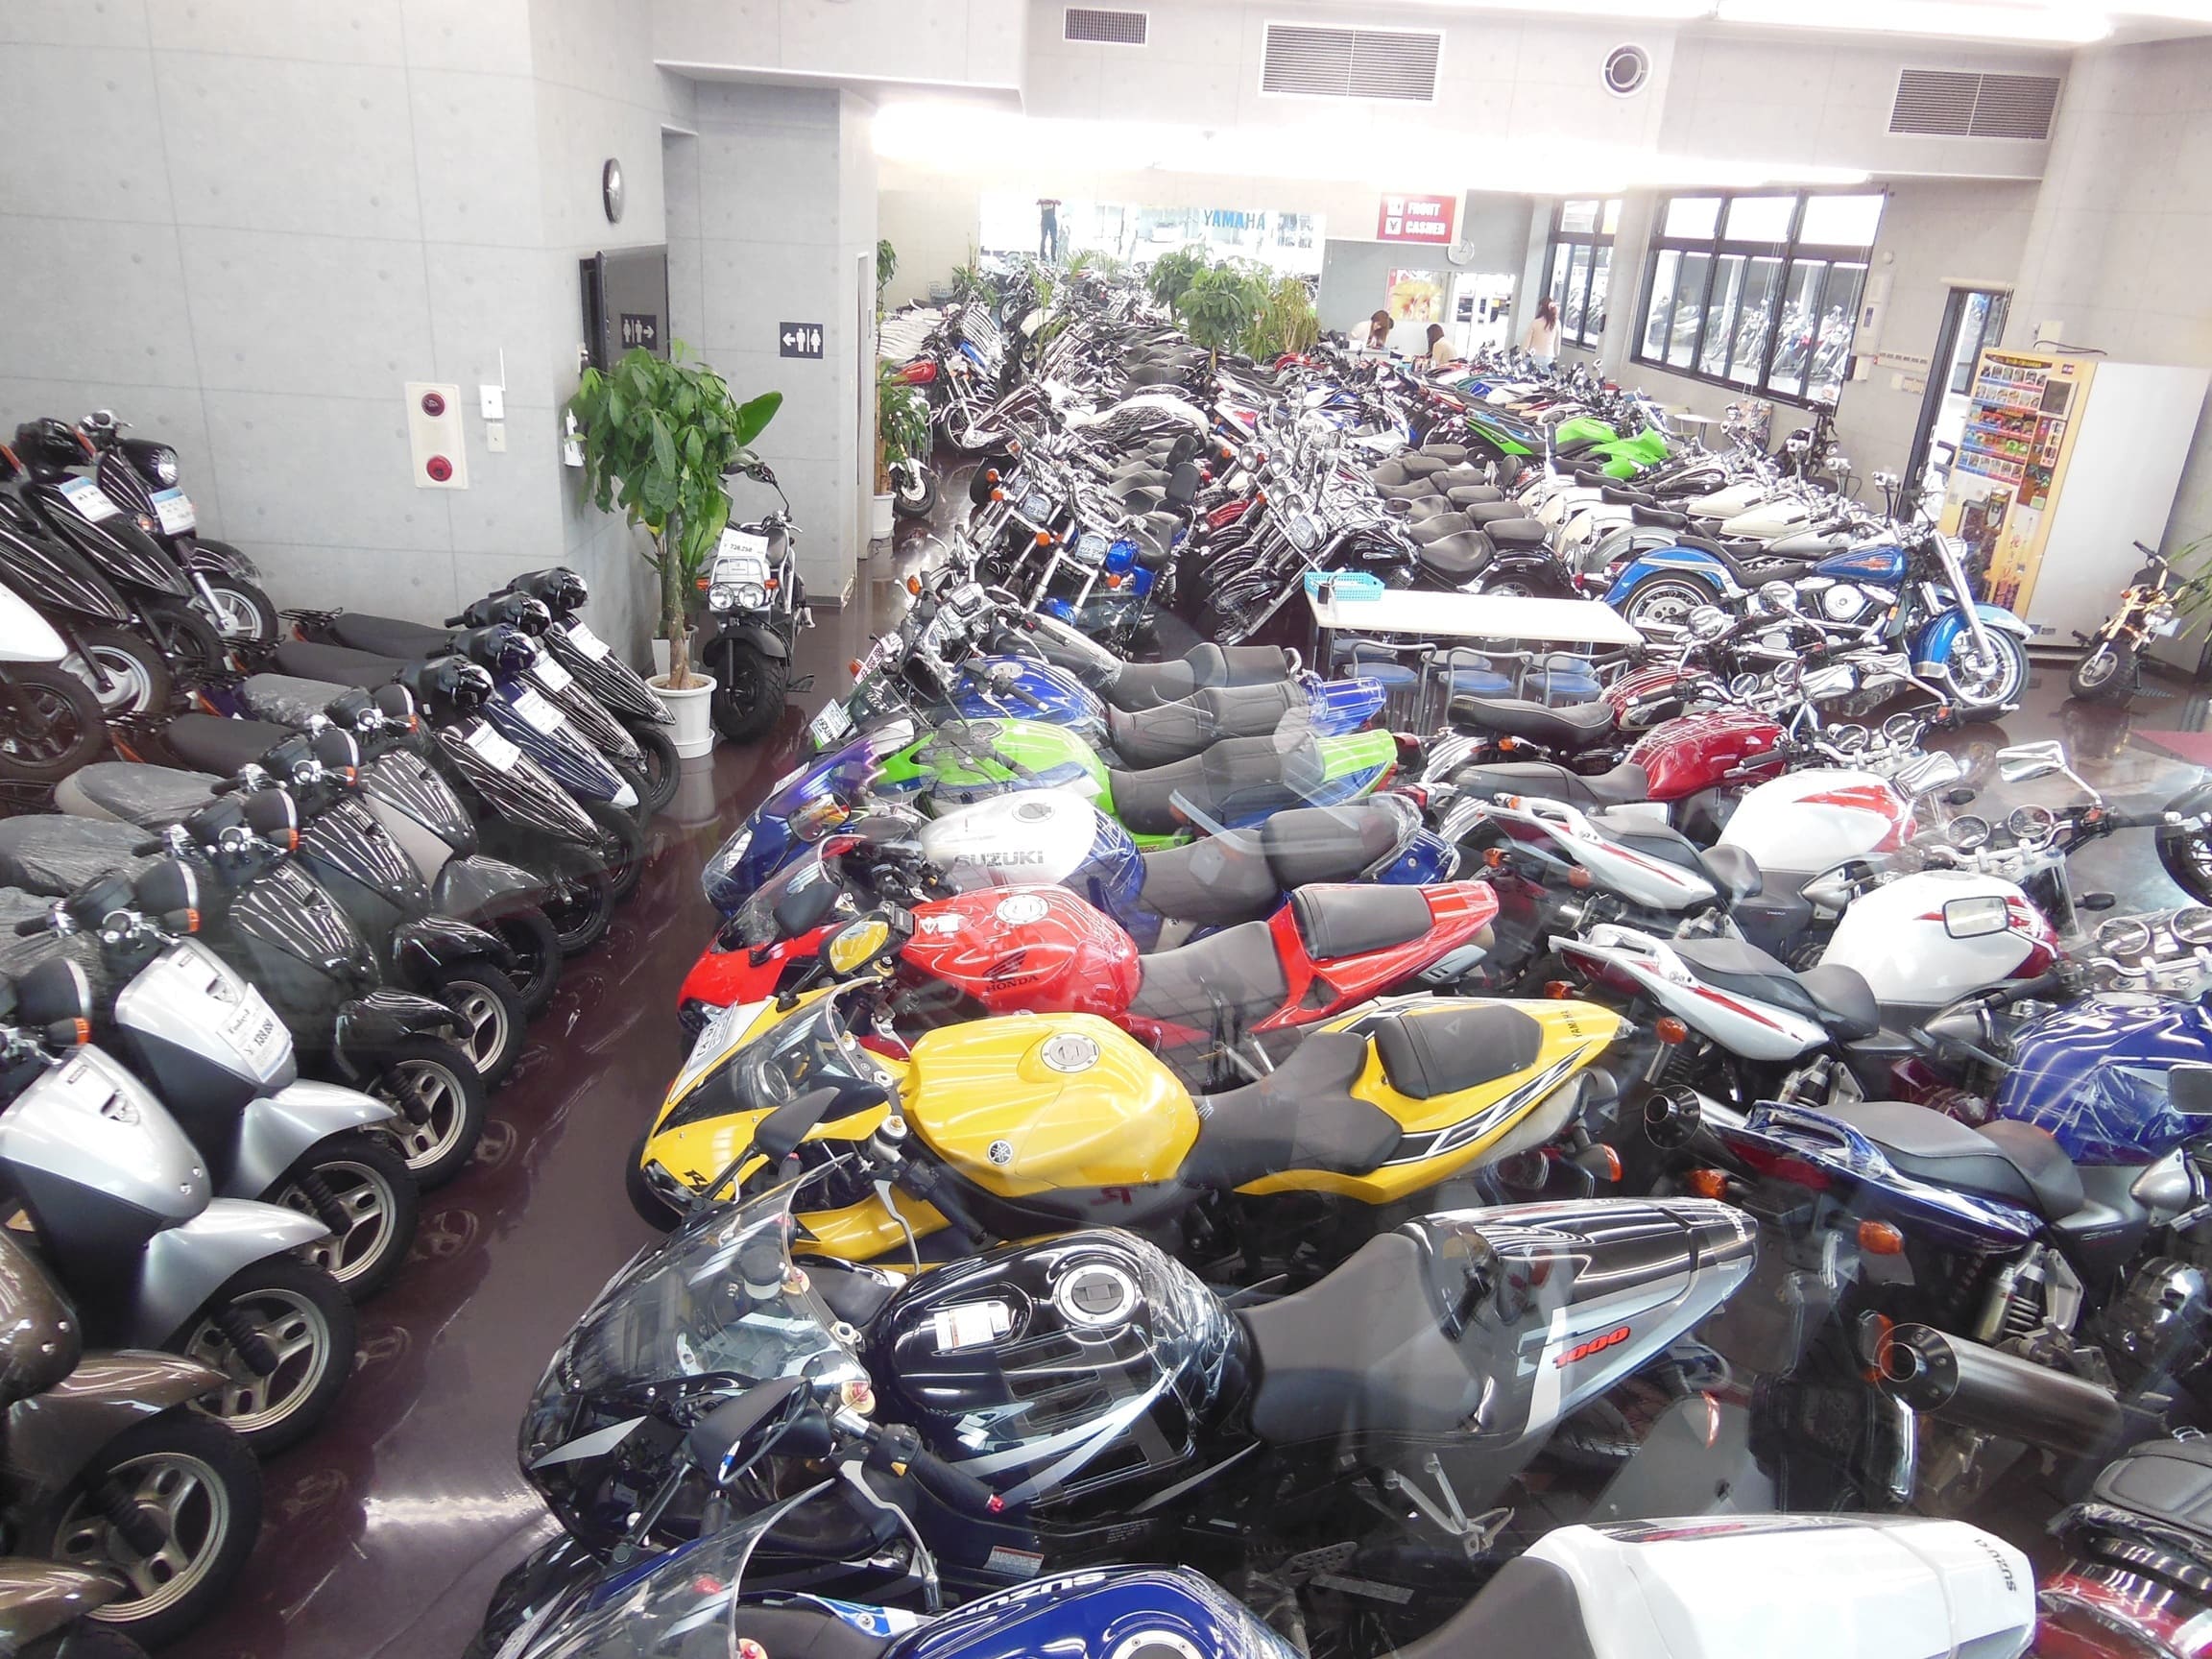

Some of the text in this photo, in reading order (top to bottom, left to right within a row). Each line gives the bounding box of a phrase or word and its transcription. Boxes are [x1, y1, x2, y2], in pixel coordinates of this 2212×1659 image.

[1203, 208, 1266, 231] YAMAHA
[953, 850, 1045, 867] SUZUKI
[985, 974, 1039, 992] HONDA
[1552, 1326, 1631, 1370] 1000
